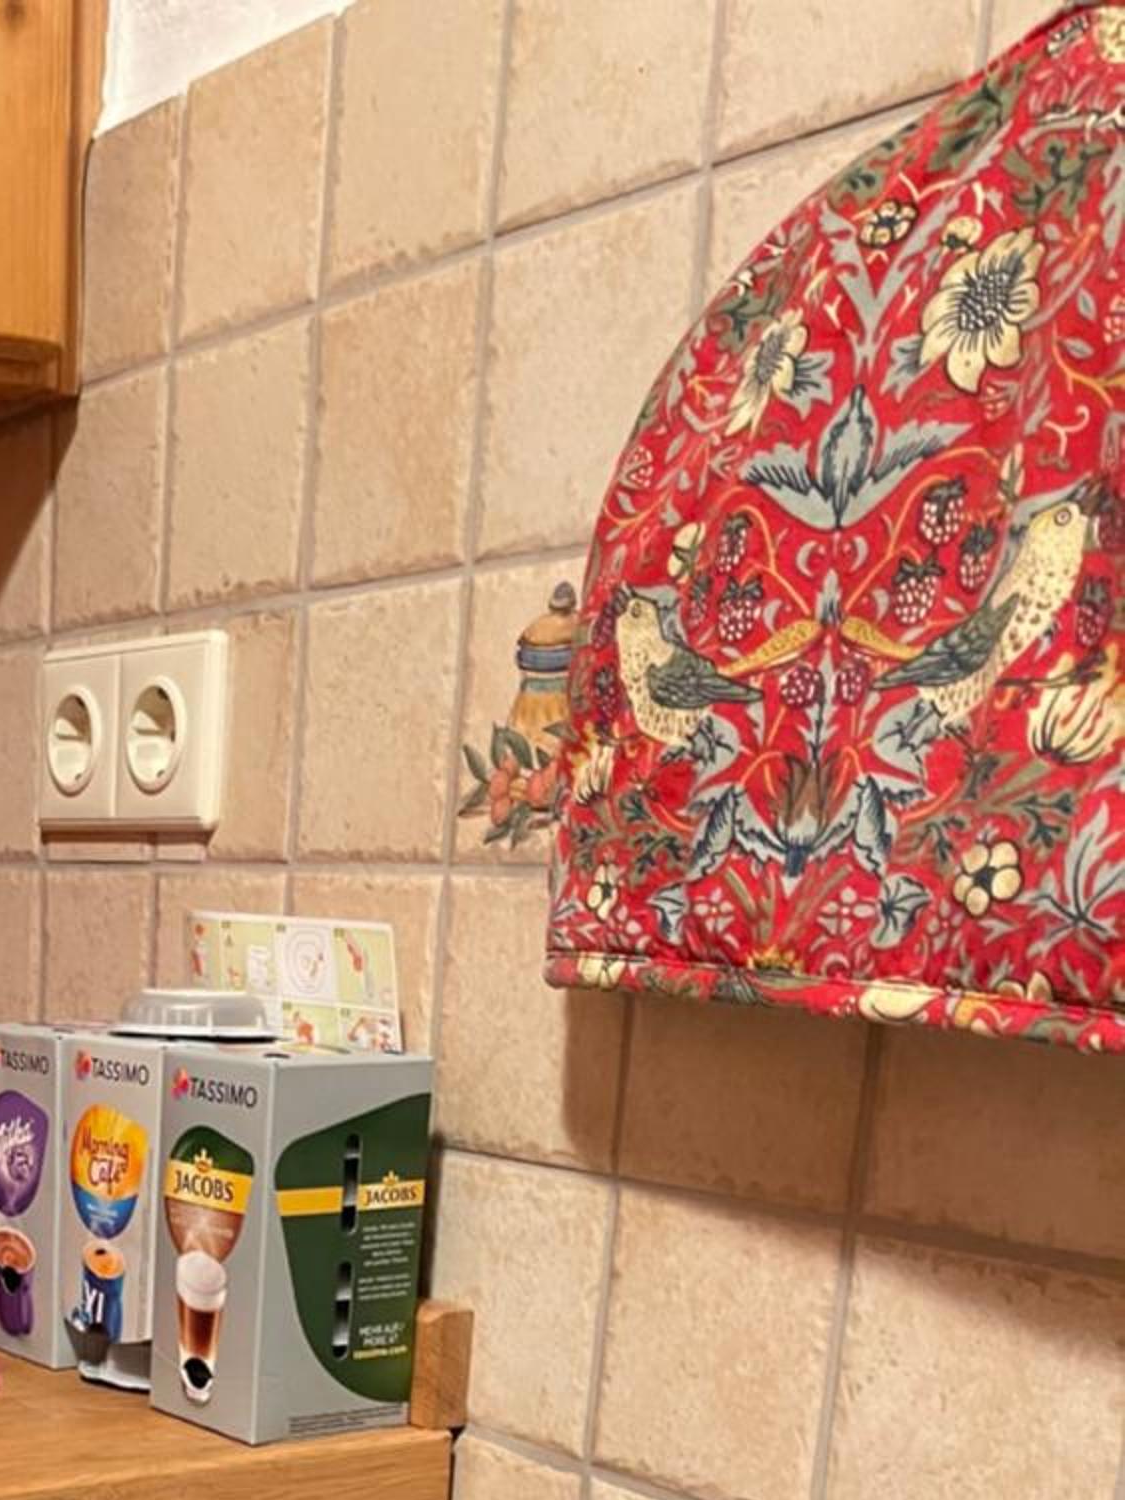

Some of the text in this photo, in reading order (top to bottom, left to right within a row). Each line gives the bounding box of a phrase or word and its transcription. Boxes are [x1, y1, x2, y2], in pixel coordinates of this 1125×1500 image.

[0, 1048, 50, 1075] TASSIMO
[91, 1057, 150, 1086] TASSIMO
[189, 1076, 258, 1109] TASSIMO
[173, 1169, 235, 1203] JACOBS
[366, 1184, 418, 1207] JACOBS
